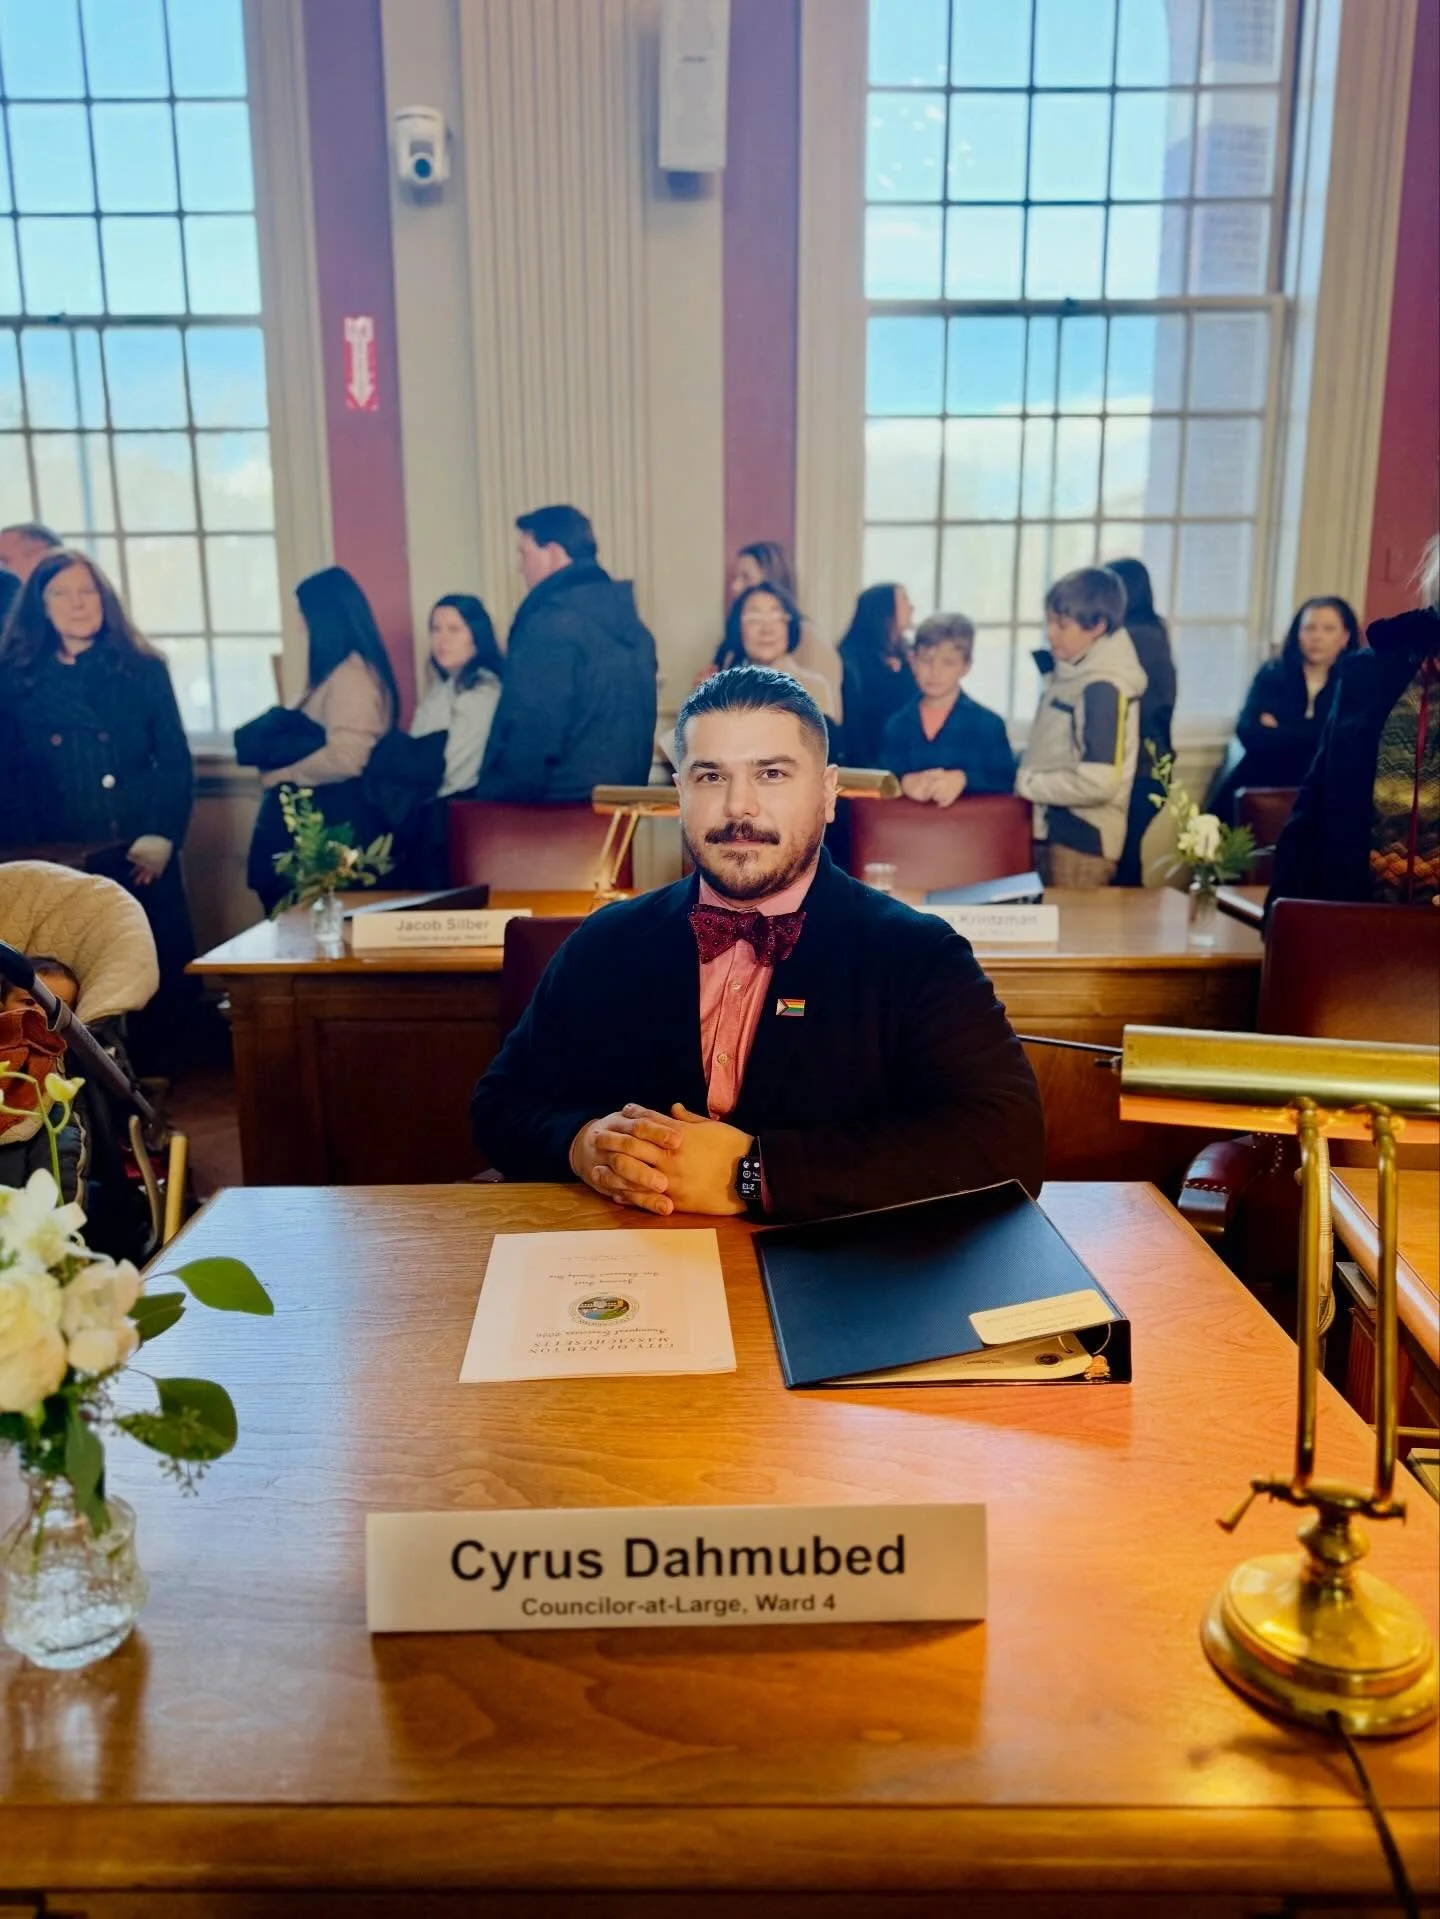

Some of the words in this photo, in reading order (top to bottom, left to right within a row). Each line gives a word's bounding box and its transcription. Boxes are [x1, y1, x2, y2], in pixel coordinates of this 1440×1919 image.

[396, 918, 442, 932] Jacob
[446, 918, 491, 932] Silber
[450, 1538, 604, 1592] Cyrus
[625, 1534, 906, 1579] Dahmubed
[521, 1597, 748, 1616] Councilor-at-Large,
[755, 1595, 815, 1613] Ward
[821, 1595, 836, 1611] 4
